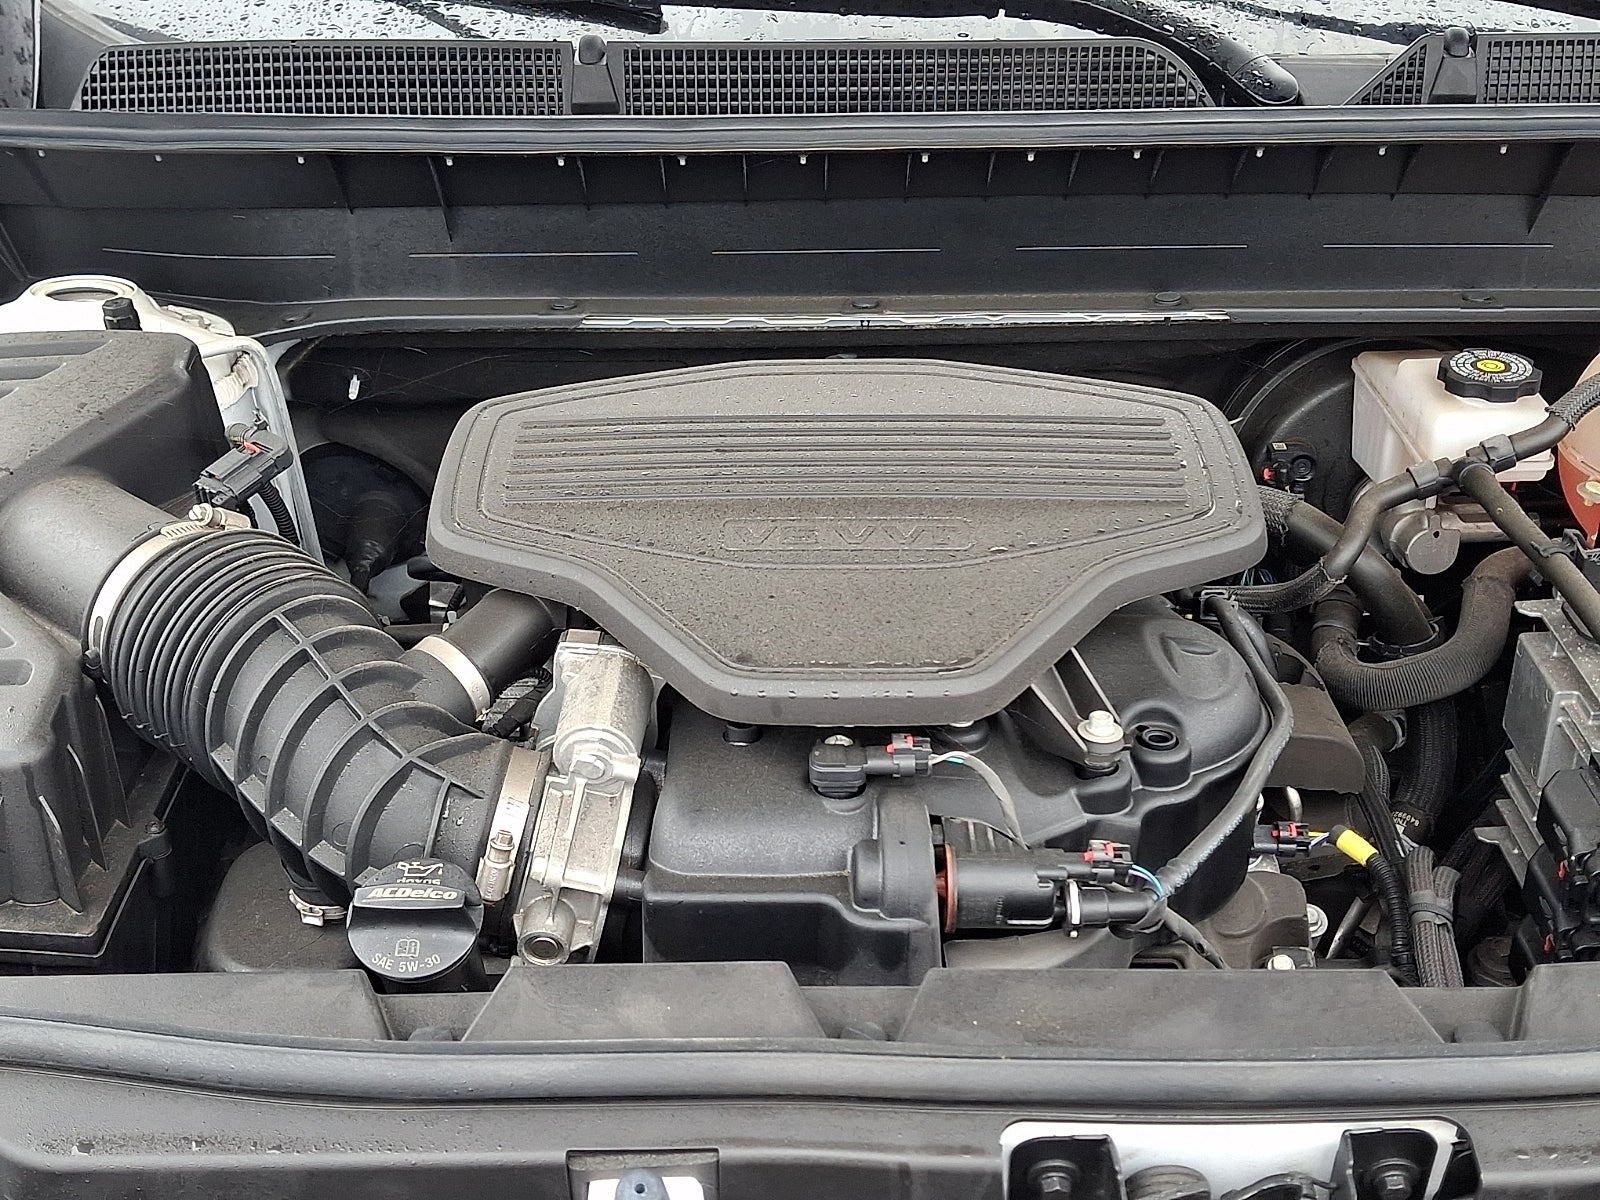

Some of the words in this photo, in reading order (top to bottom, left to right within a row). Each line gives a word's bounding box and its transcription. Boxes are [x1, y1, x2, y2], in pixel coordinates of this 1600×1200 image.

[366, 887, 458, 900] ACDelco
[371, 952, 395, 971] SAE
[398, 954, 441, 973] 5W-30
